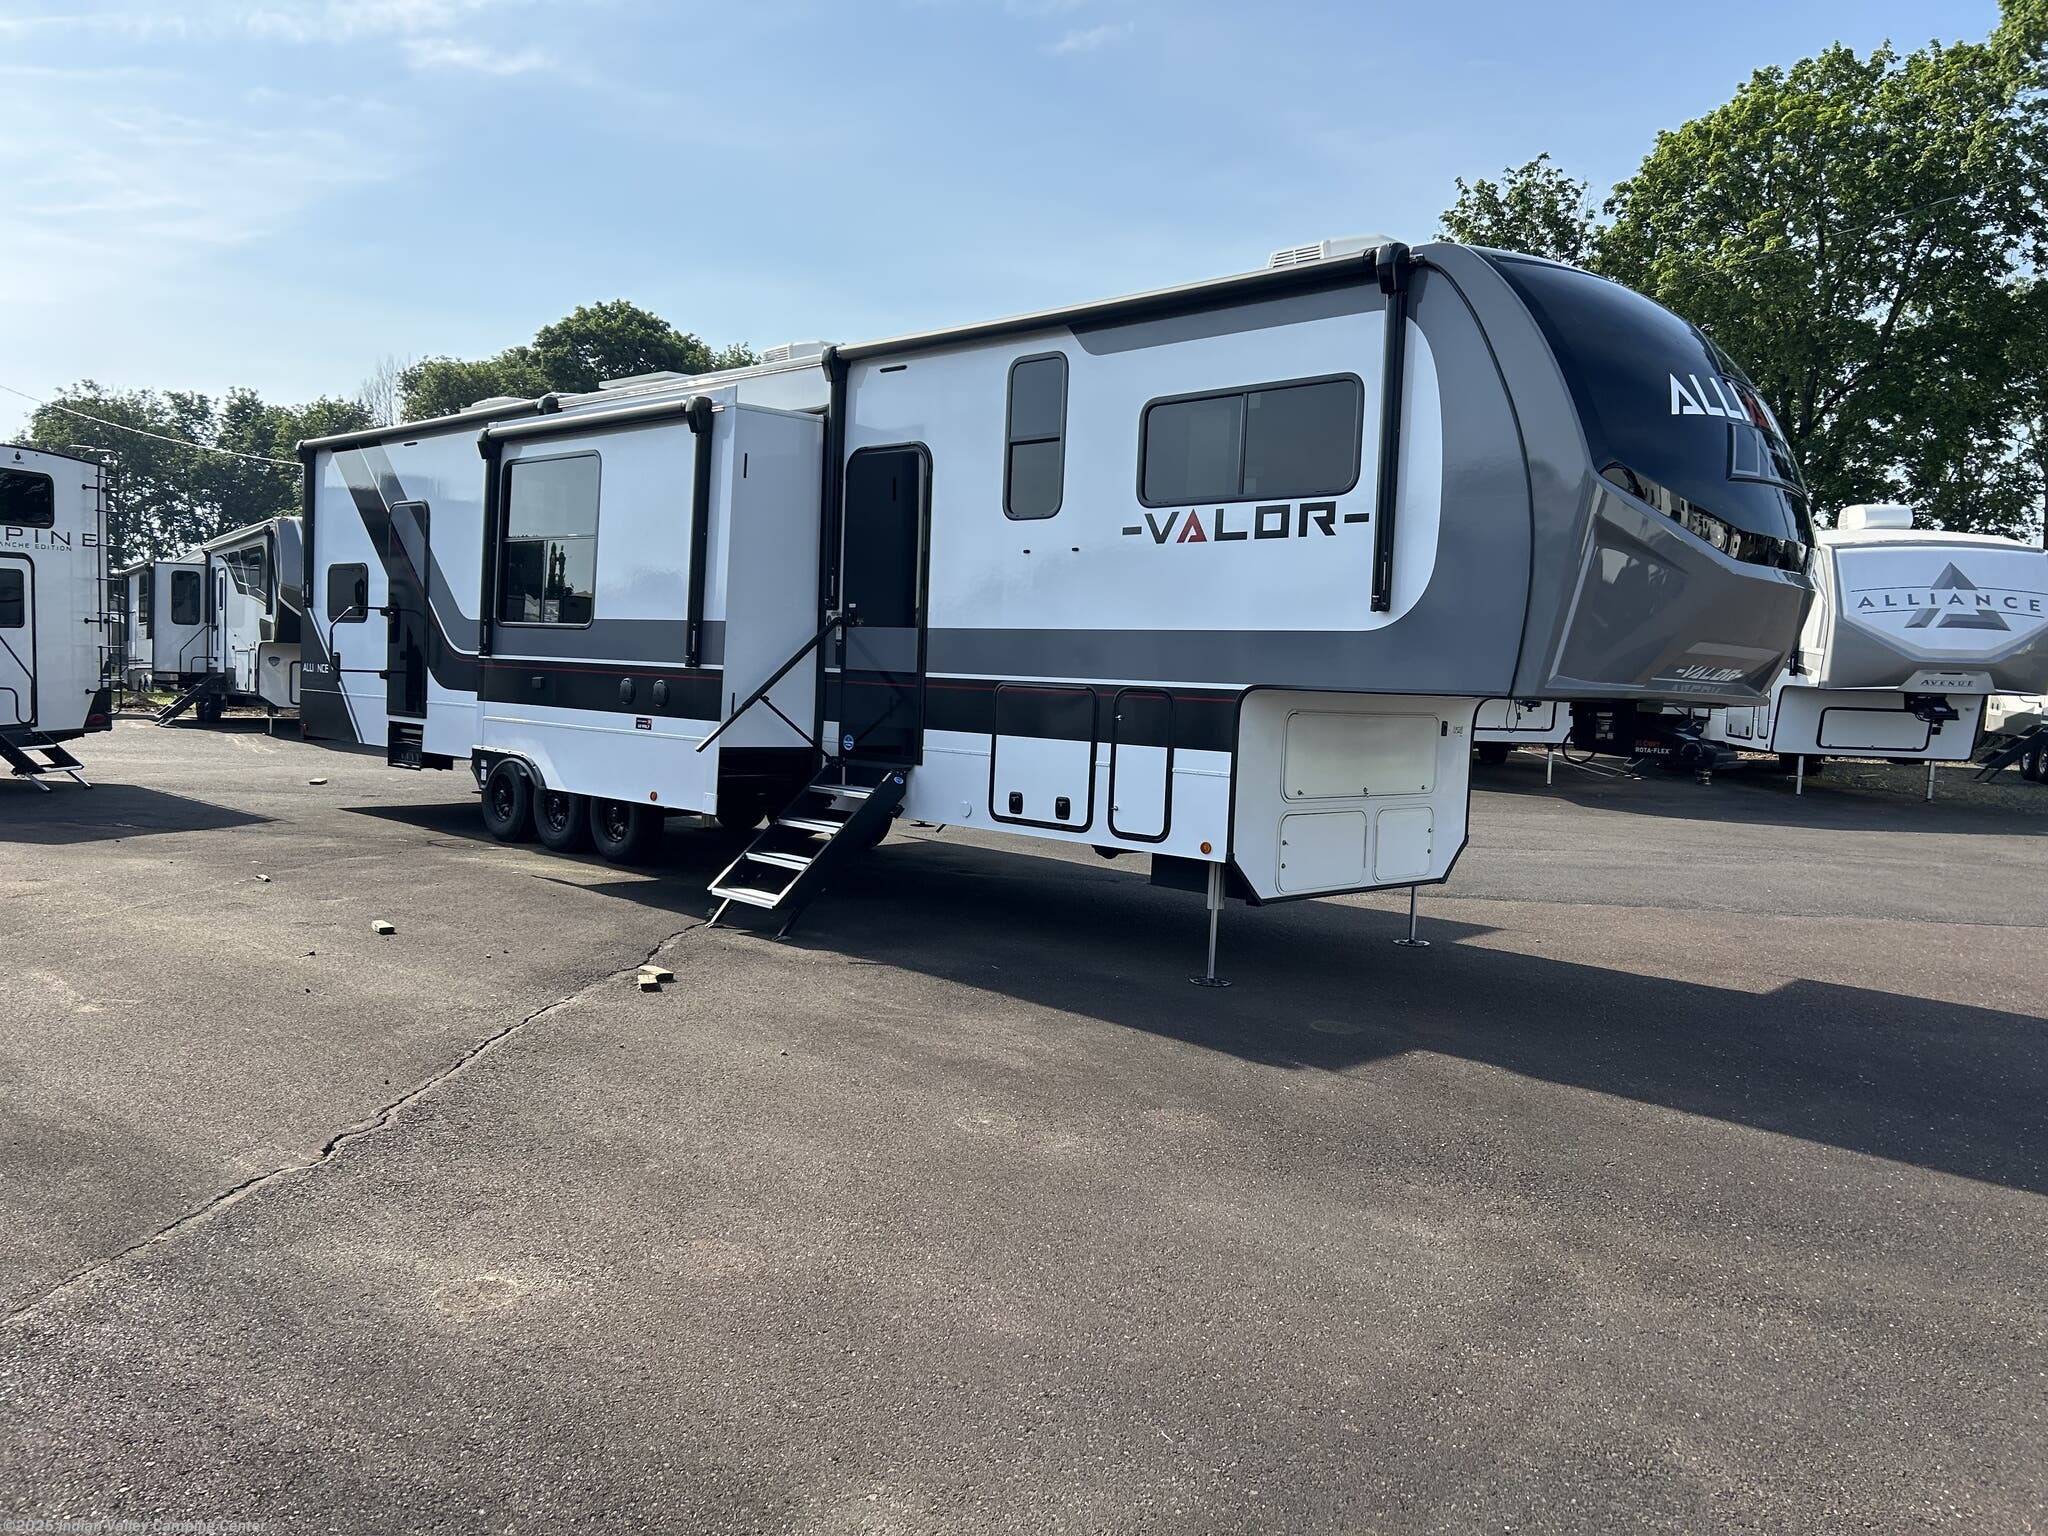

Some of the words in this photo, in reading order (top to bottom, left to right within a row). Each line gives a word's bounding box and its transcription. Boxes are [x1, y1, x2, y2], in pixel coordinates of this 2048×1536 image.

[1669, 372, 1778, 434] ALLIA
[34, 543, 72, 552] EDITION
[1857, 592, 2042, 612] ALLIANCE
[302, 662, 329, 674] ALLINCE
[1920, 679, 1976, 688] AVENUE
